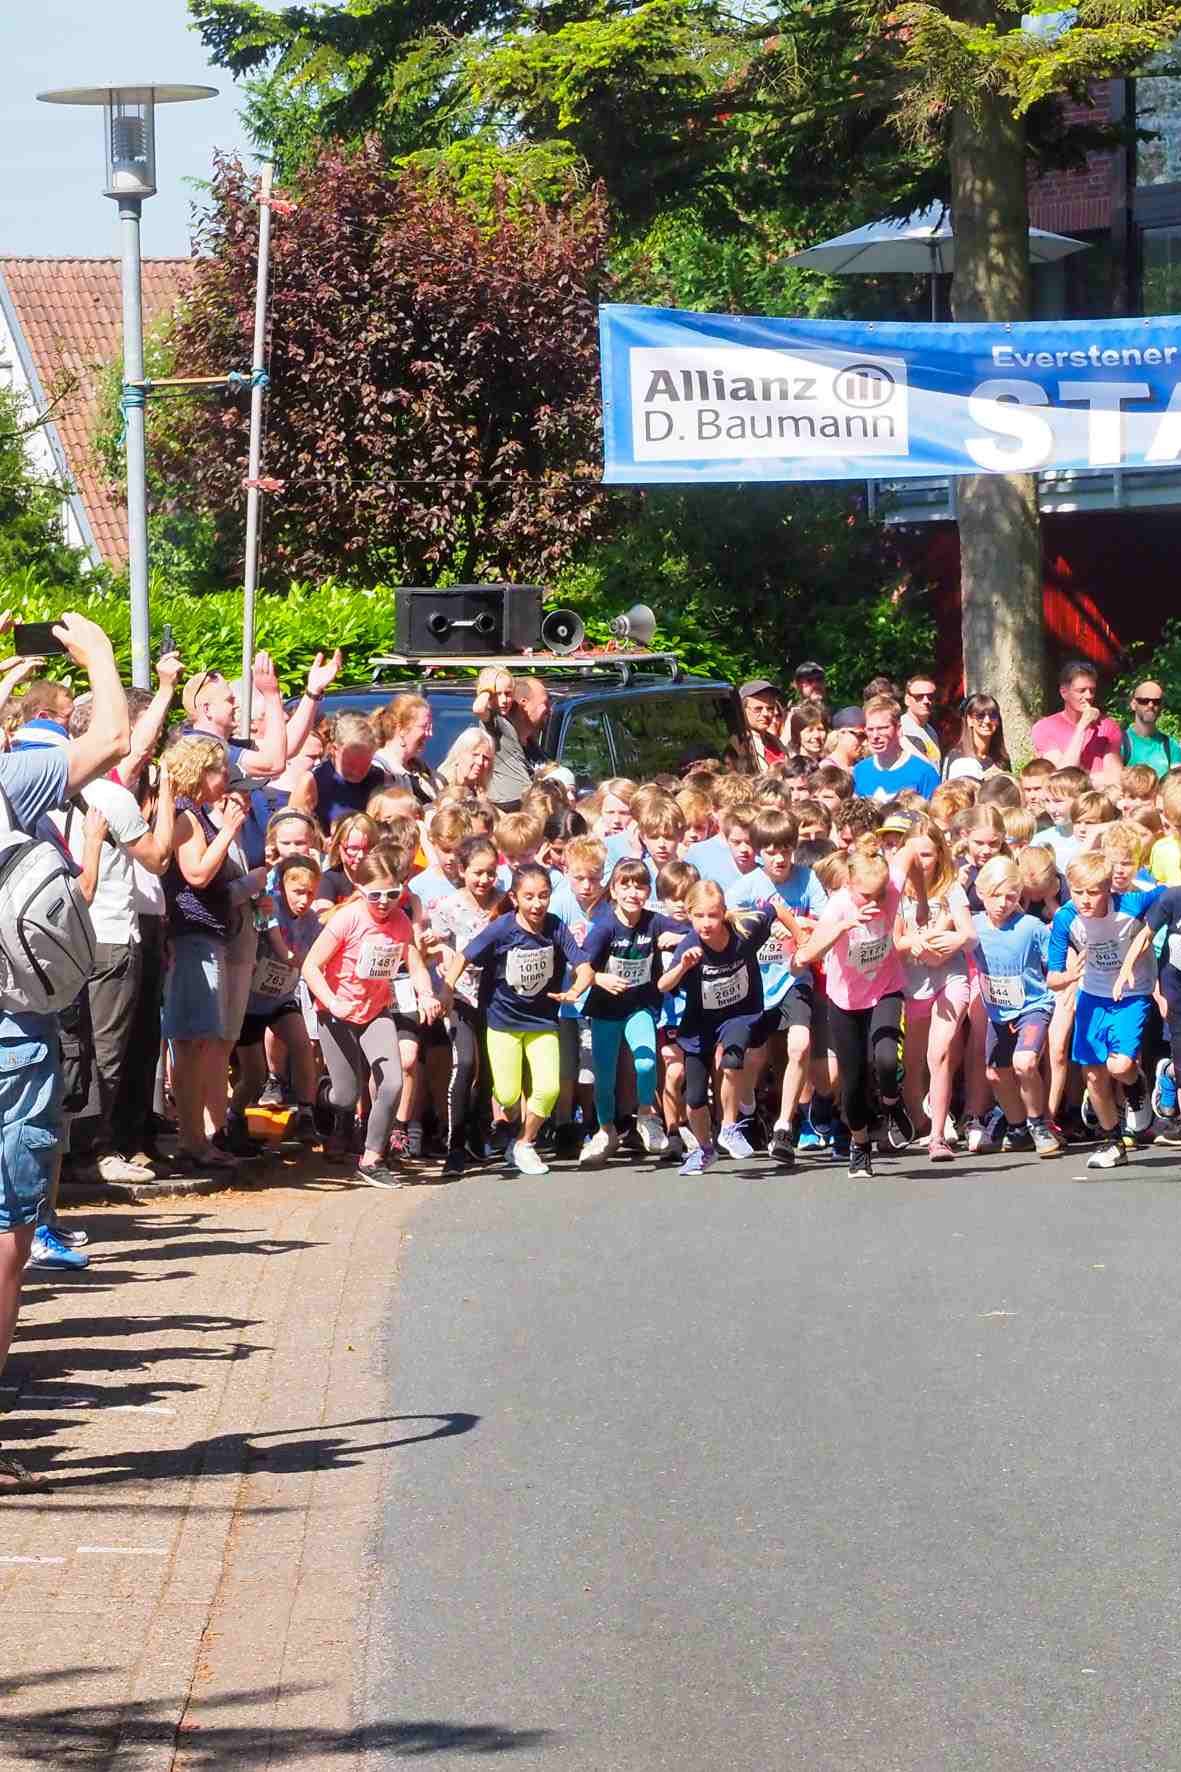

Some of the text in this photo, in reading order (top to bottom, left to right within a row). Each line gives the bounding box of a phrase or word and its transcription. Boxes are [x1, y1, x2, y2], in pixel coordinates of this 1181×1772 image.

[991, 345, 1177, 369] Everstener
[643, 369, 817, 402] Allianz
[644, 409, 895, 441] D. Baumann
[371, 957, 395, 967] 1481
[519, 961, 546, 974] 1010
